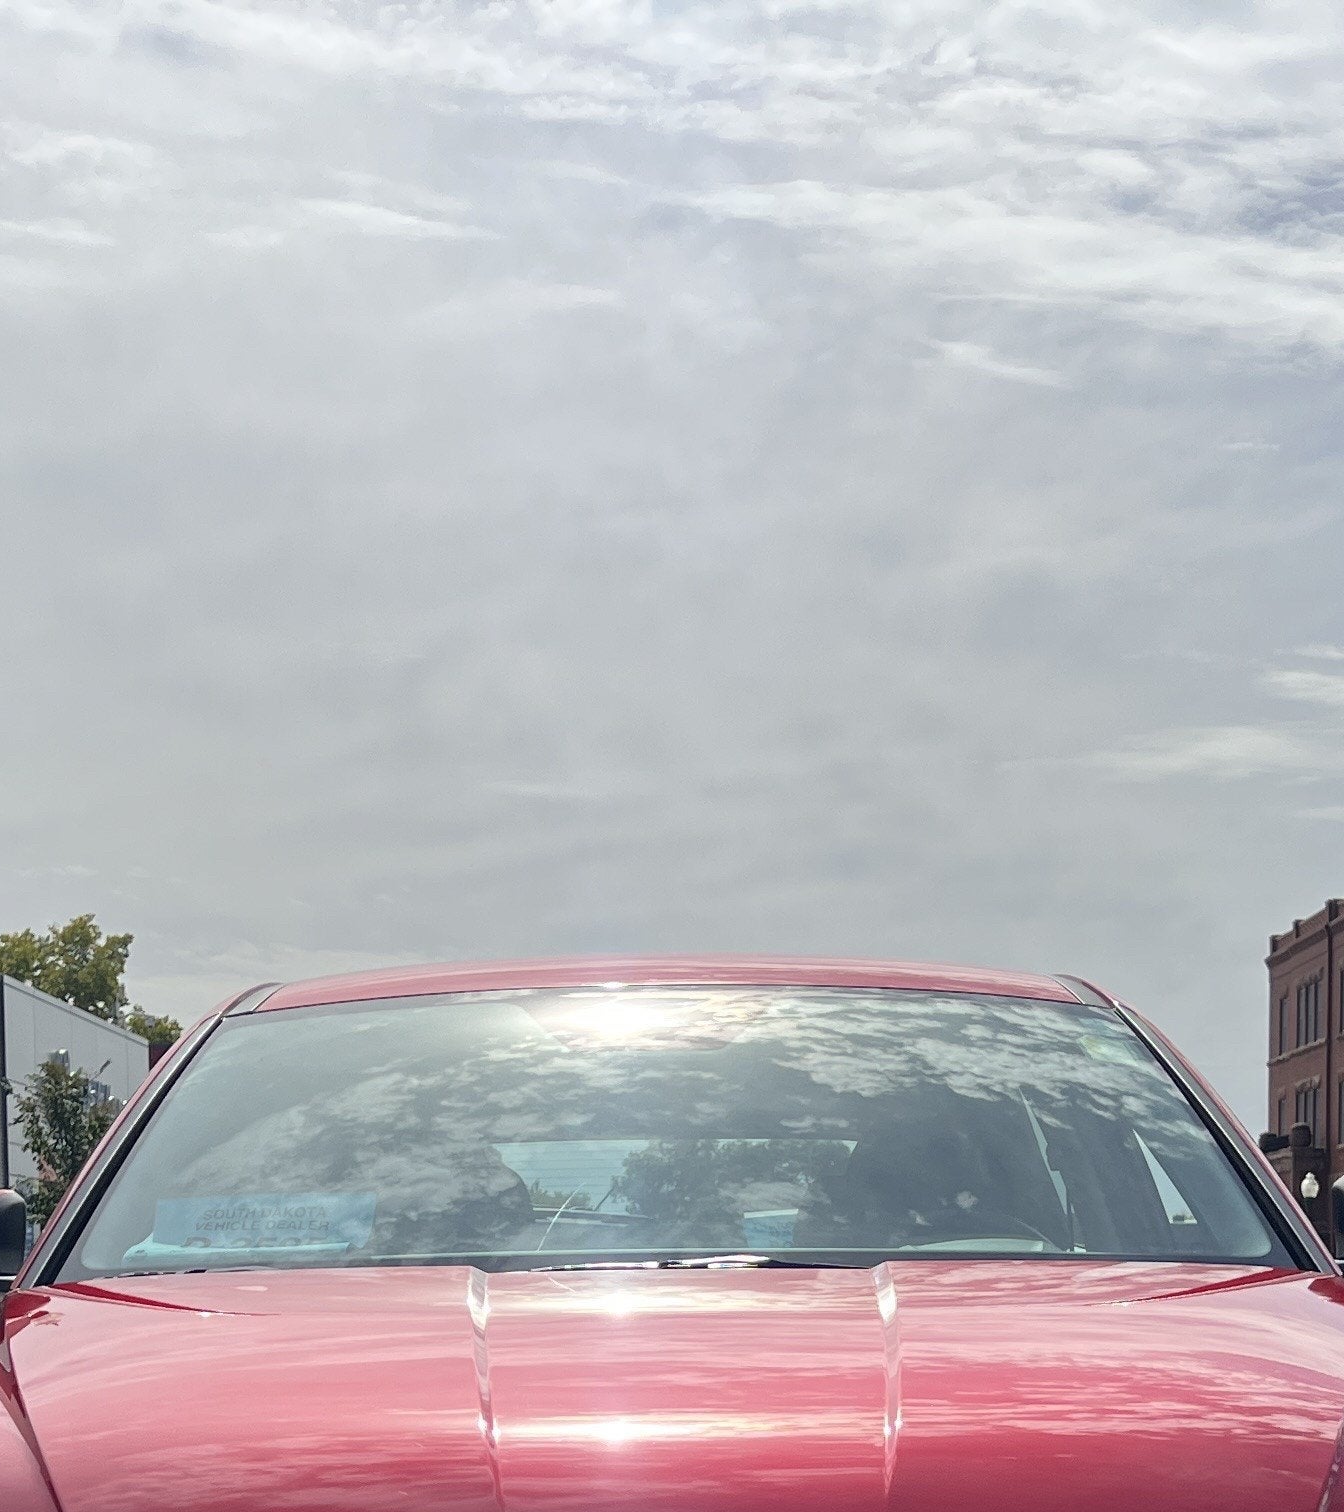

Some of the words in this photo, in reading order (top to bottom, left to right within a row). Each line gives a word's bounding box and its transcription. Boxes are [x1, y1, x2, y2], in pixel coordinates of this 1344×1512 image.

[202, 1206, 256, 1219] SOUTH
[260, 1206, 327, 1219] DAKOTA
[195, 1220, 257, 1232] VEHICLE
[264, 1220, 330, 1232] DEALER
